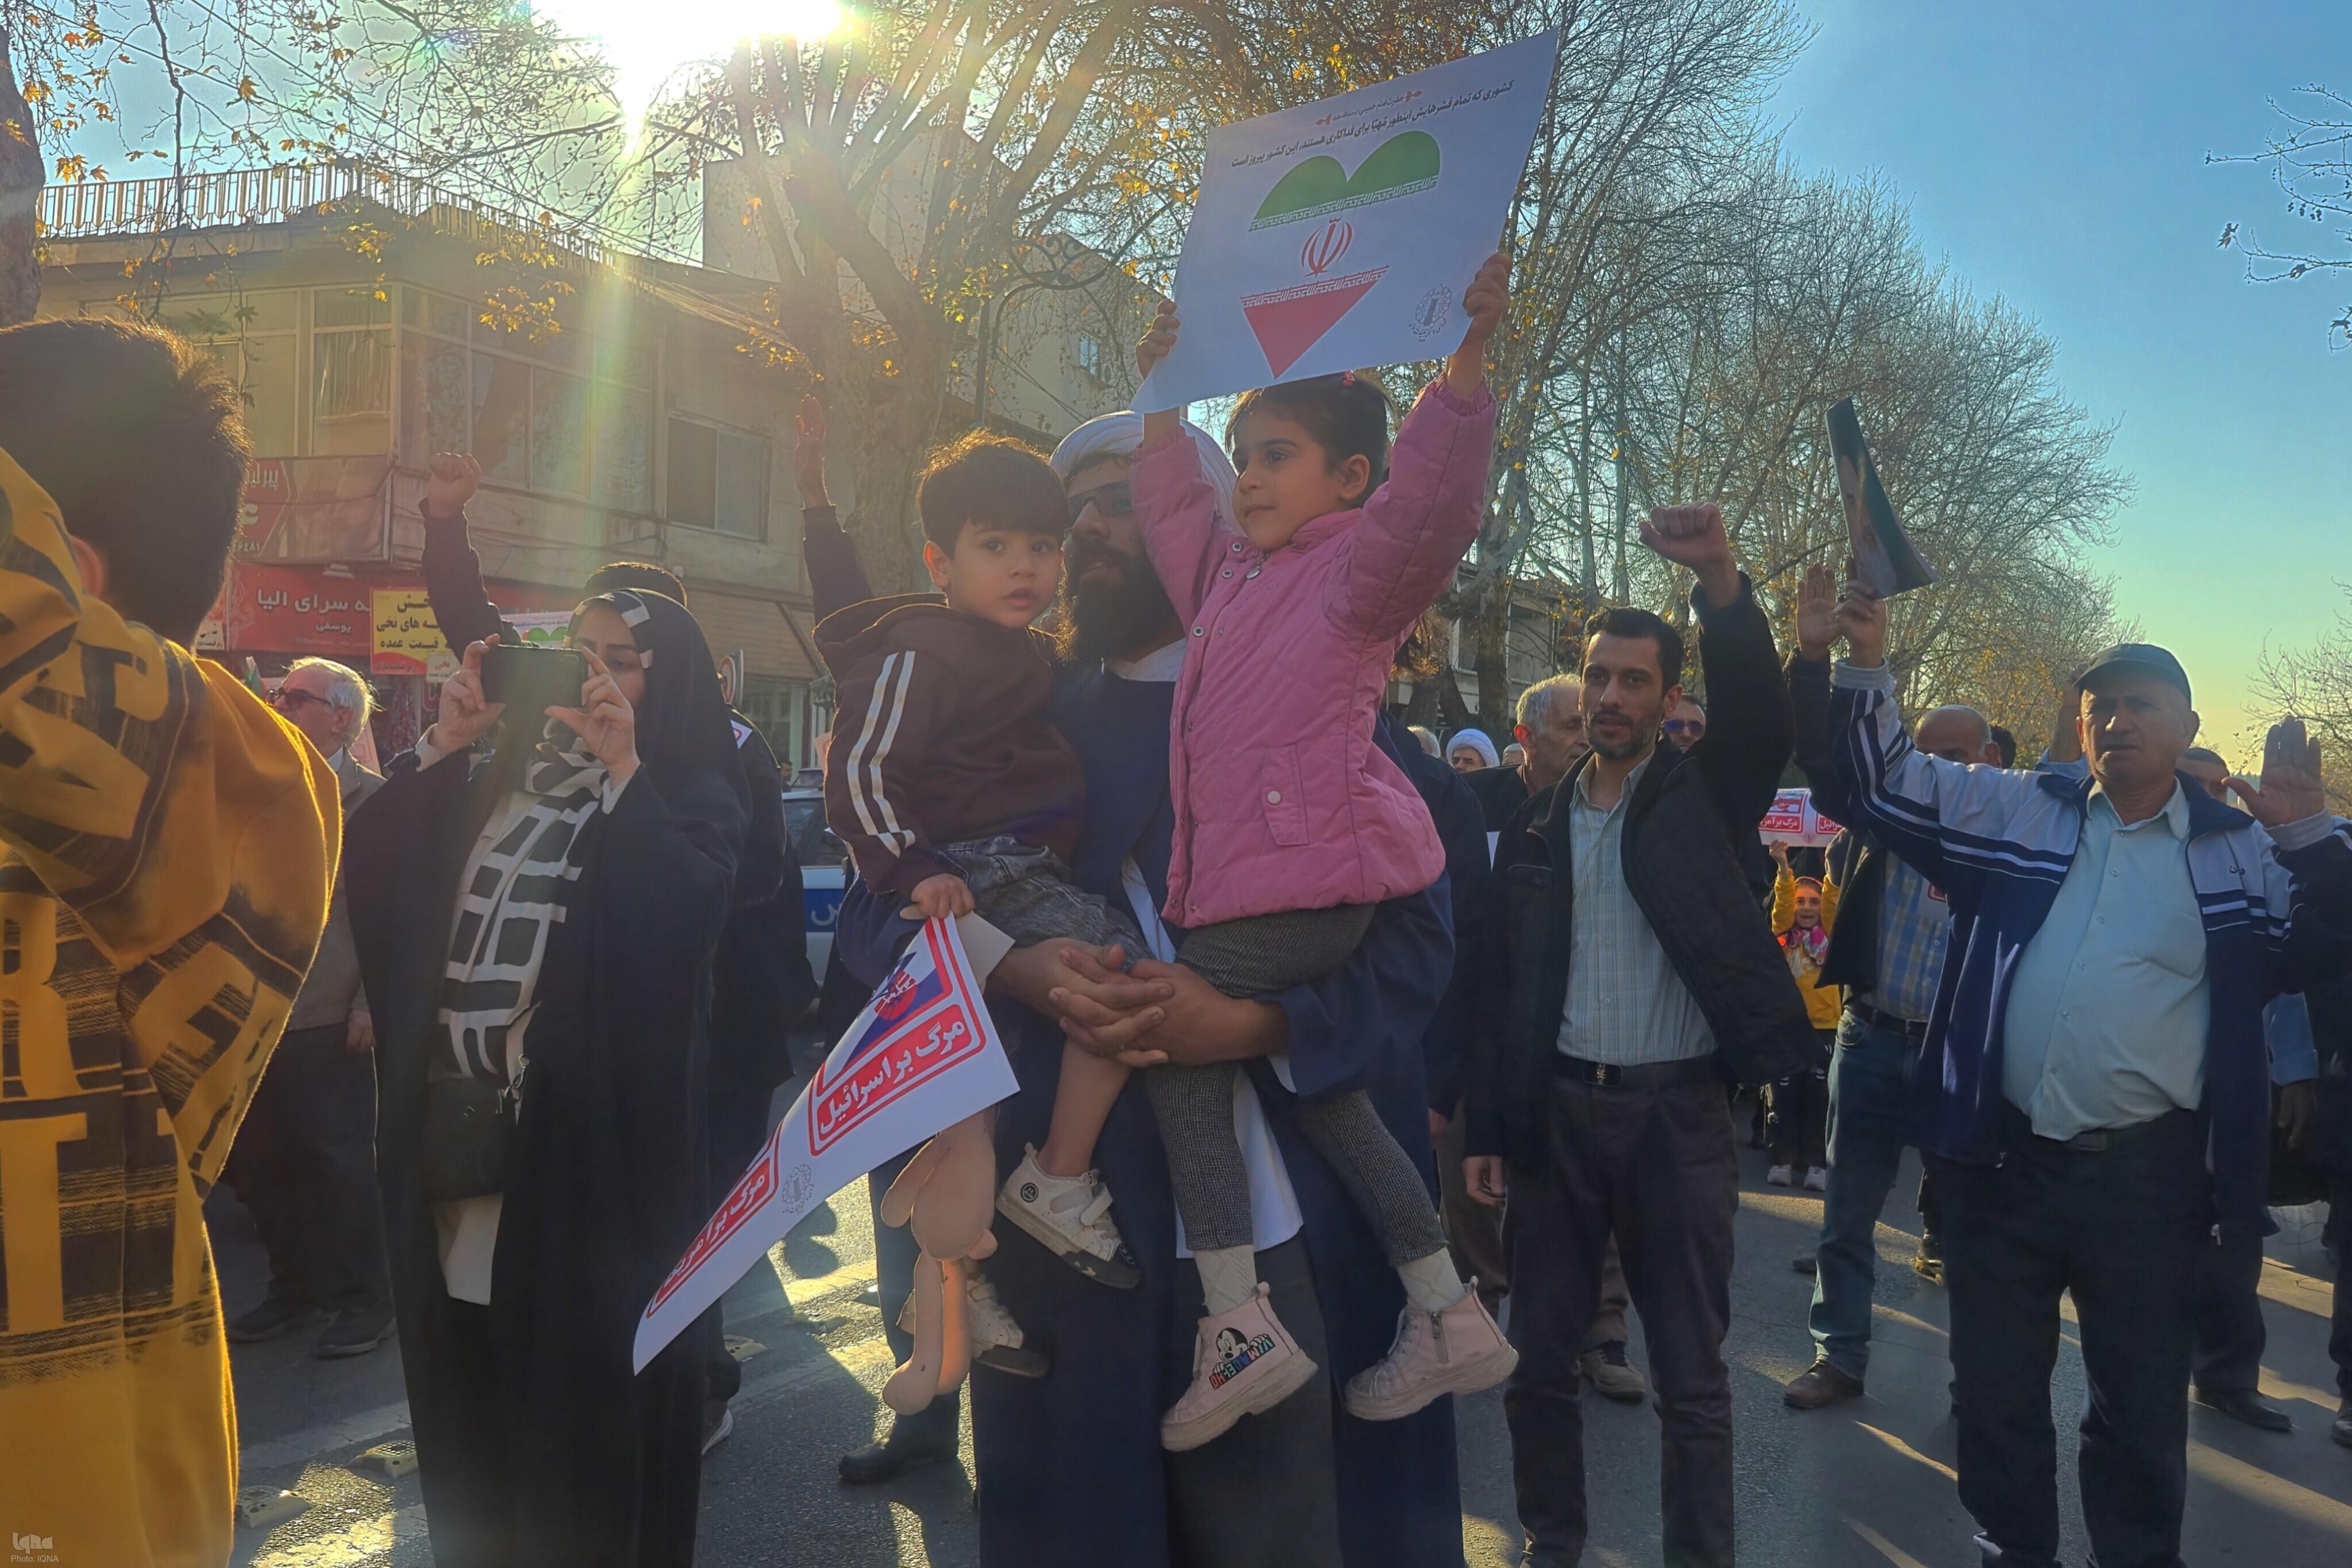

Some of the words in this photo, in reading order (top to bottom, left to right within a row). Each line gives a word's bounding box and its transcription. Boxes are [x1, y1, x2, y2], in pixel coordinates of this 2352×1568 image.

[1472, 88, 1484, 101] که
[1483, 79, 1515, 101] کشوری
[1411, 96, 1453, 121] قشرهایش
[1452, 94, 1472, 111] تمام
[1387, 109, 1413, 129] اینطور
[1325, 125, 1355, 145] فداکاری
[1354, 122, 1371, 138] برای
[1264, 144, 1287, 162] کشور
[1285, 140, 1299, 156] این
[1231, 153, 1249, 167] است
[1248, 153, 1265, 167] پیروز
[257, 589, 288, 611] الیا
[294, 594, 349, 614] سرای
[315, 620, 352, 634] یوسفی
[377, 615, 398, 632] نخی
[400, 617, 420, 632] های
[380, 639, 403, 649] عمده
[409, 637, 439, 652] قیمت
[1775, 820, 1782, 828] بر
[1783, 818, 1798, 828] مرگ
[915, 1021, 966, 1058] مرگ
[893, 1049, 913, 1084] بر
[820, 1055, 892, 1135] اسرائیل
[730, 1175, 765, 1216] مرگ
[709, 1210, 728, 1244] بر
